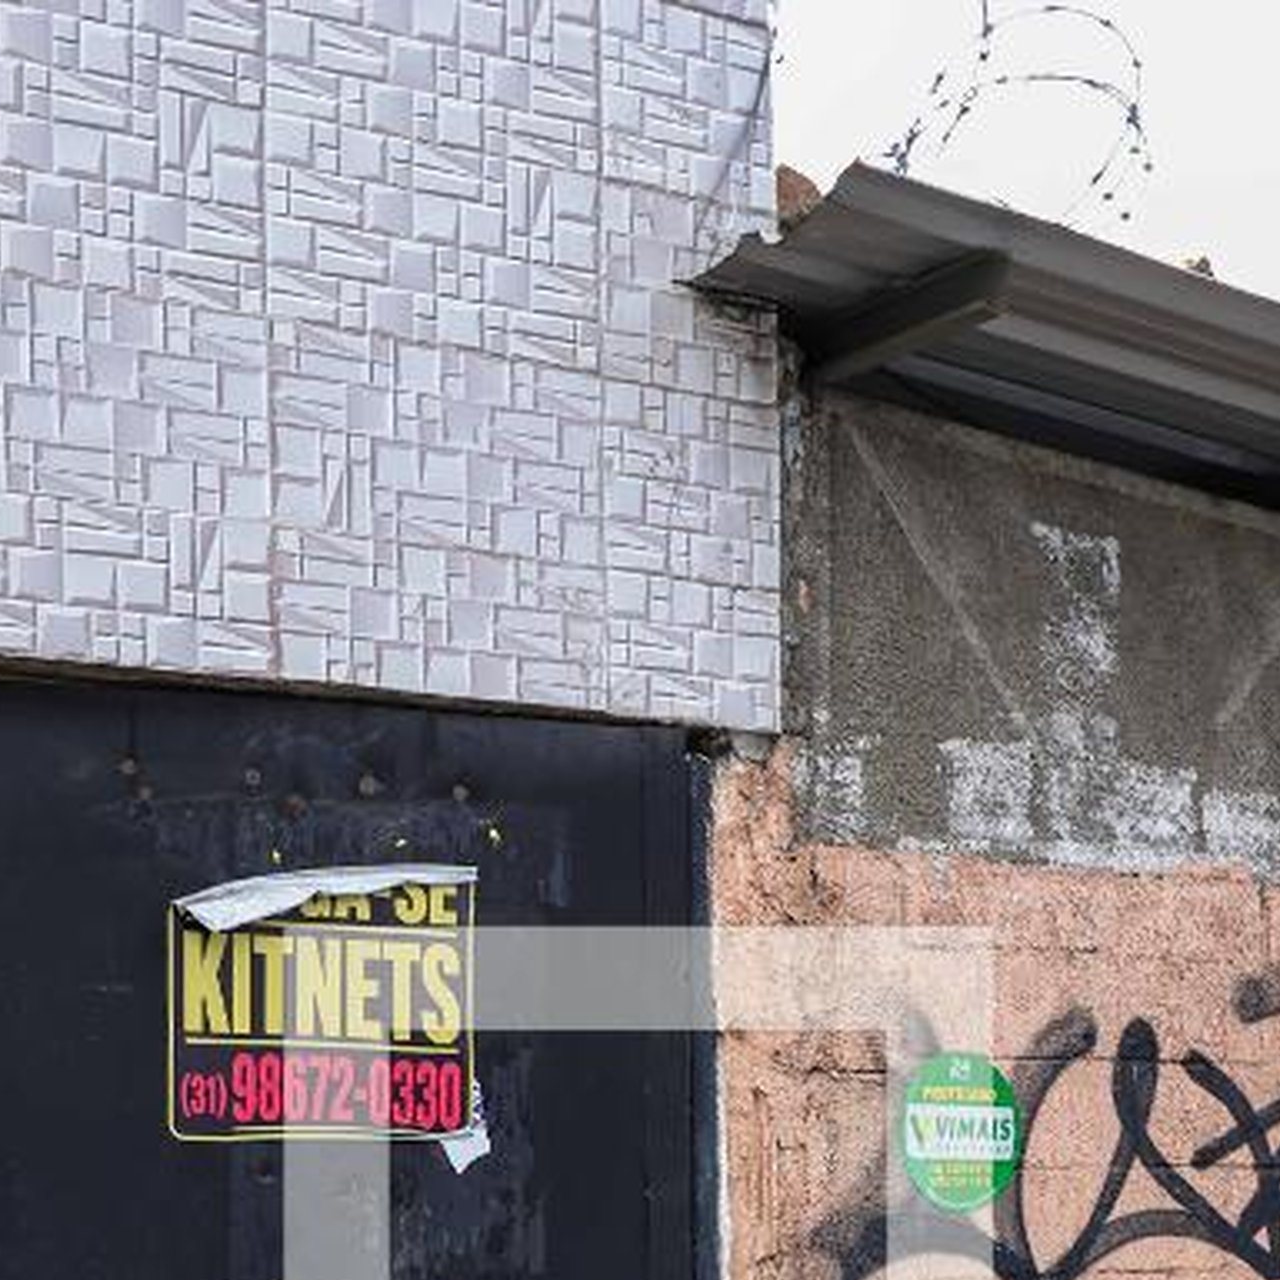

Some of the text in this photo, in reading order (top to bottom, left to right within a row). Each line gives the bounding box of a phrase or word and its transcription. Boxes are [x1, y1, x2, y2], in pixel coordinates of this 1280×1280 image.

[182, 929, 462, 1045] KITNETS
[180, 1051, 462, 1131] (31) 98672-0330
